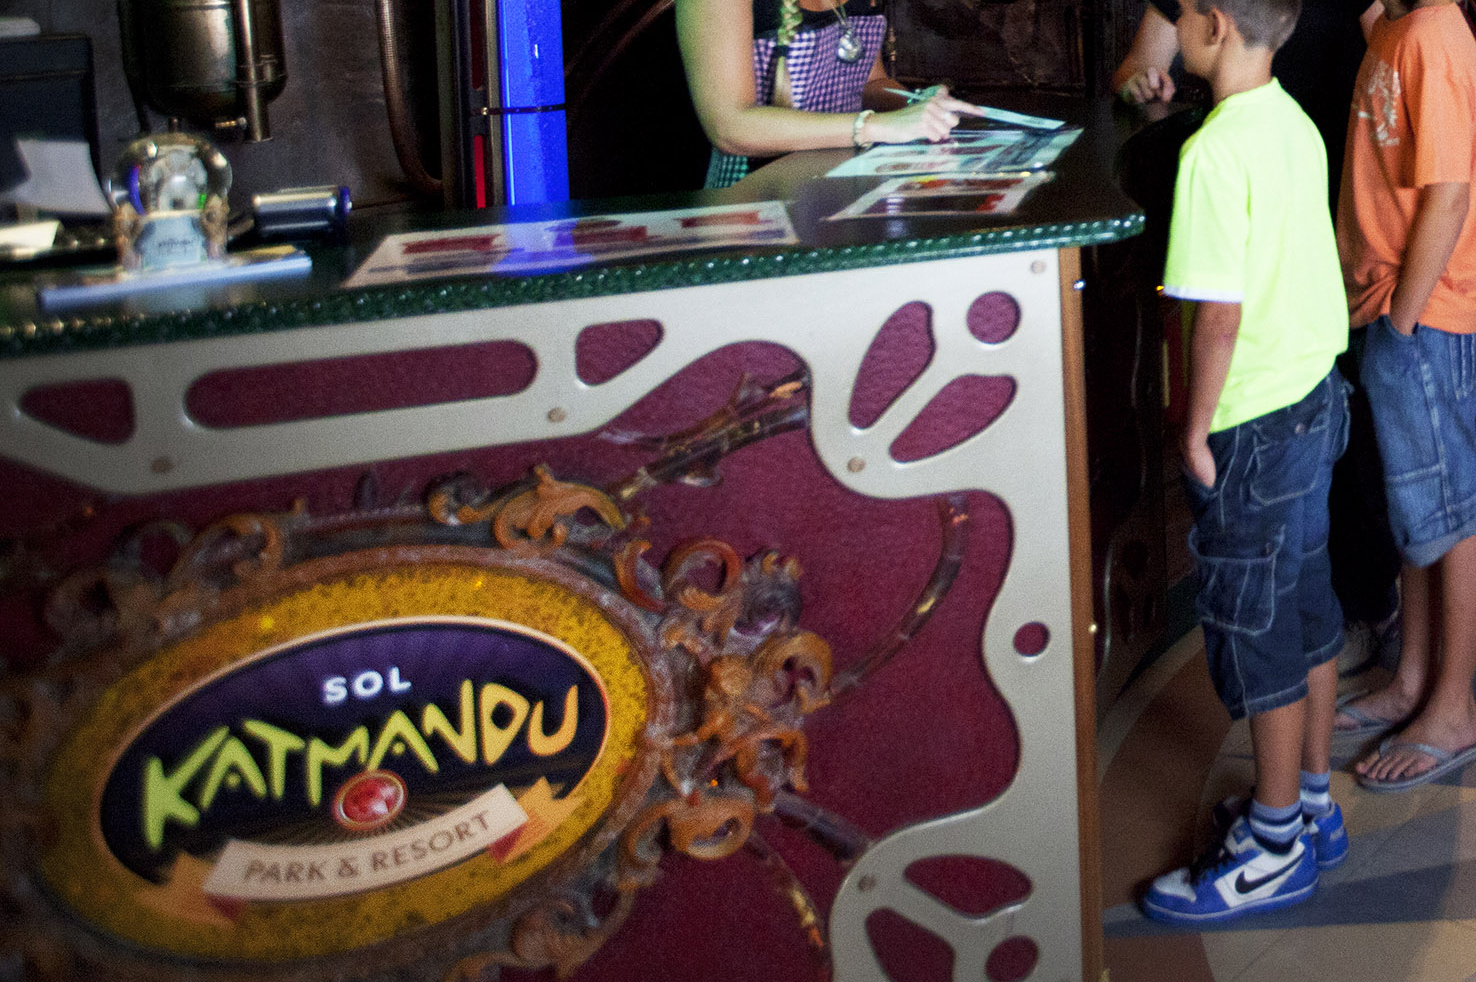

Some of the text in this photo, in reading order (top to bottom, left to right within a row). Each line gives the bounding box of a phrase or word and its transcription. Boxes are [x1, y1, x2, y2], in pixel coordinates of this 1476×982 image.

[322, 667, 412, 704] SOL
[143, 679, 579, 849] KATMANDU
[243, 814, 491, 884] PARK & RESORT
